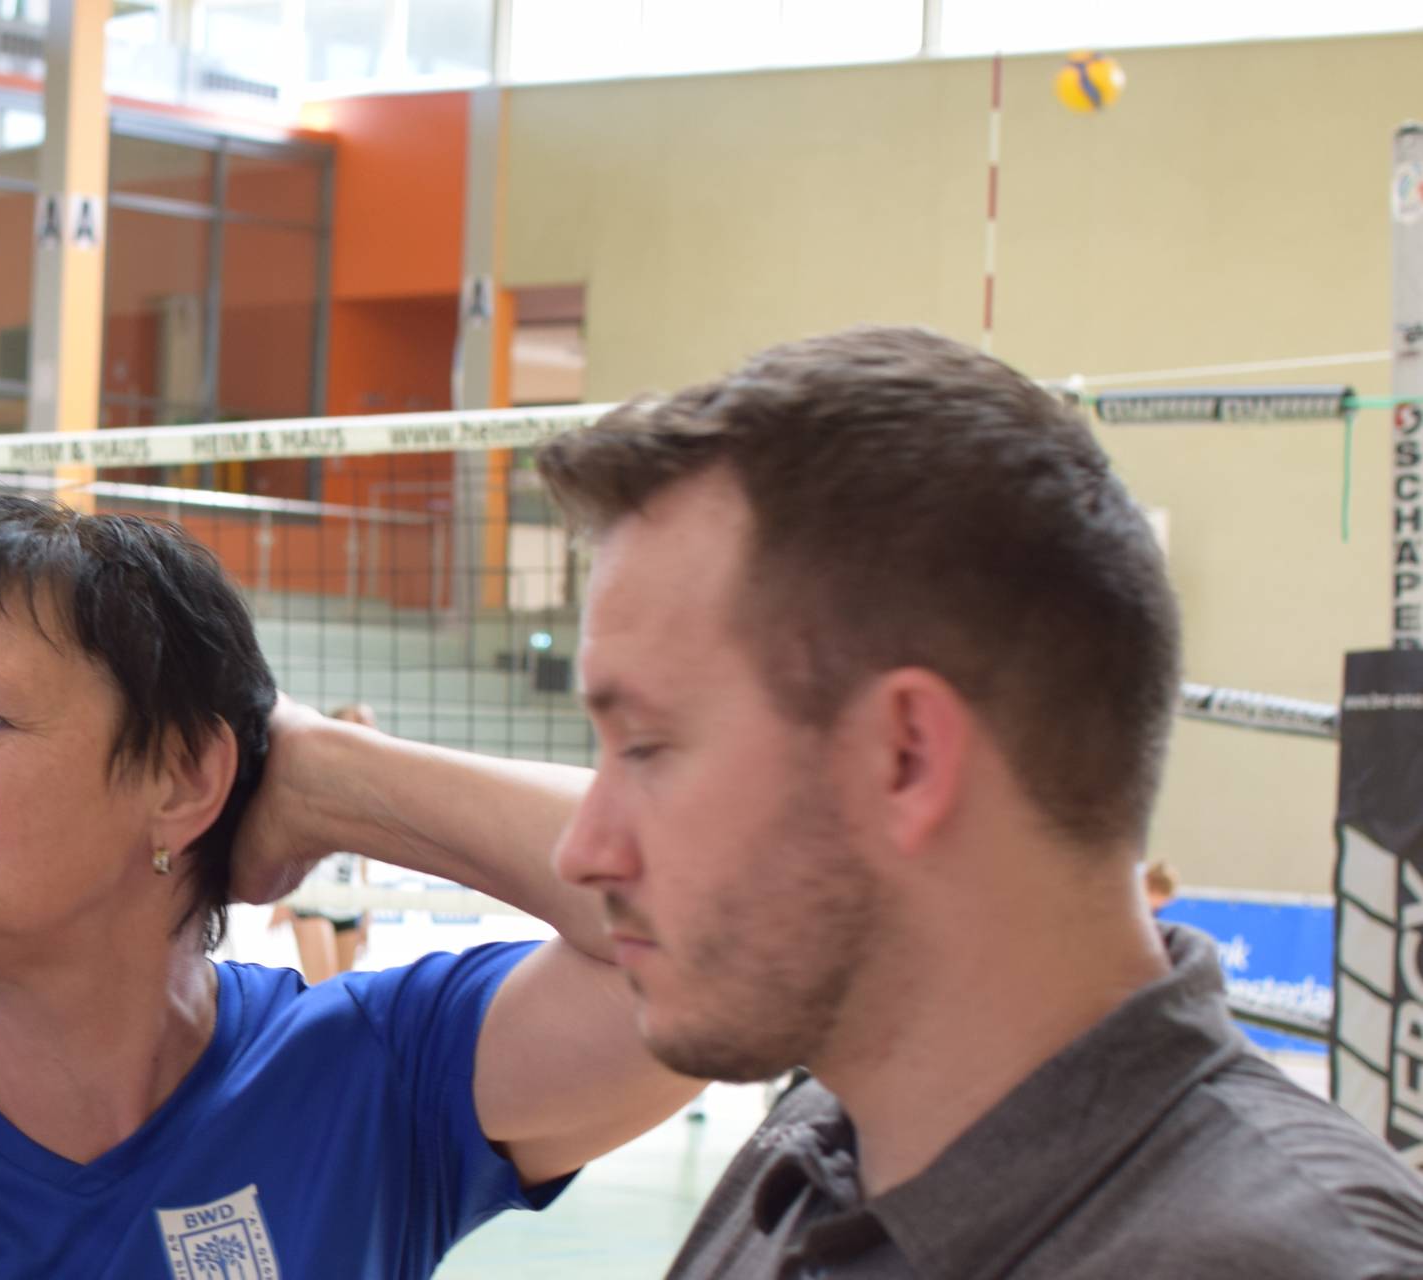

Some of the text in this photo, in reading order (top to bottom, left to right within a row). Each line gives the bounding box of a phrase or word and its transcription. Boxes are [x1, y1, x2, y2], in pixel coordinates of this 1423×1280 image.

[76, 200, 96, 245] A
[9, 441, 63, 463] HEIM
[91, 436, 152, 460] HAUS
[193, 427, 345, 455] HEIM & HAUS
[183, 1203, 235, 1229] BWD
